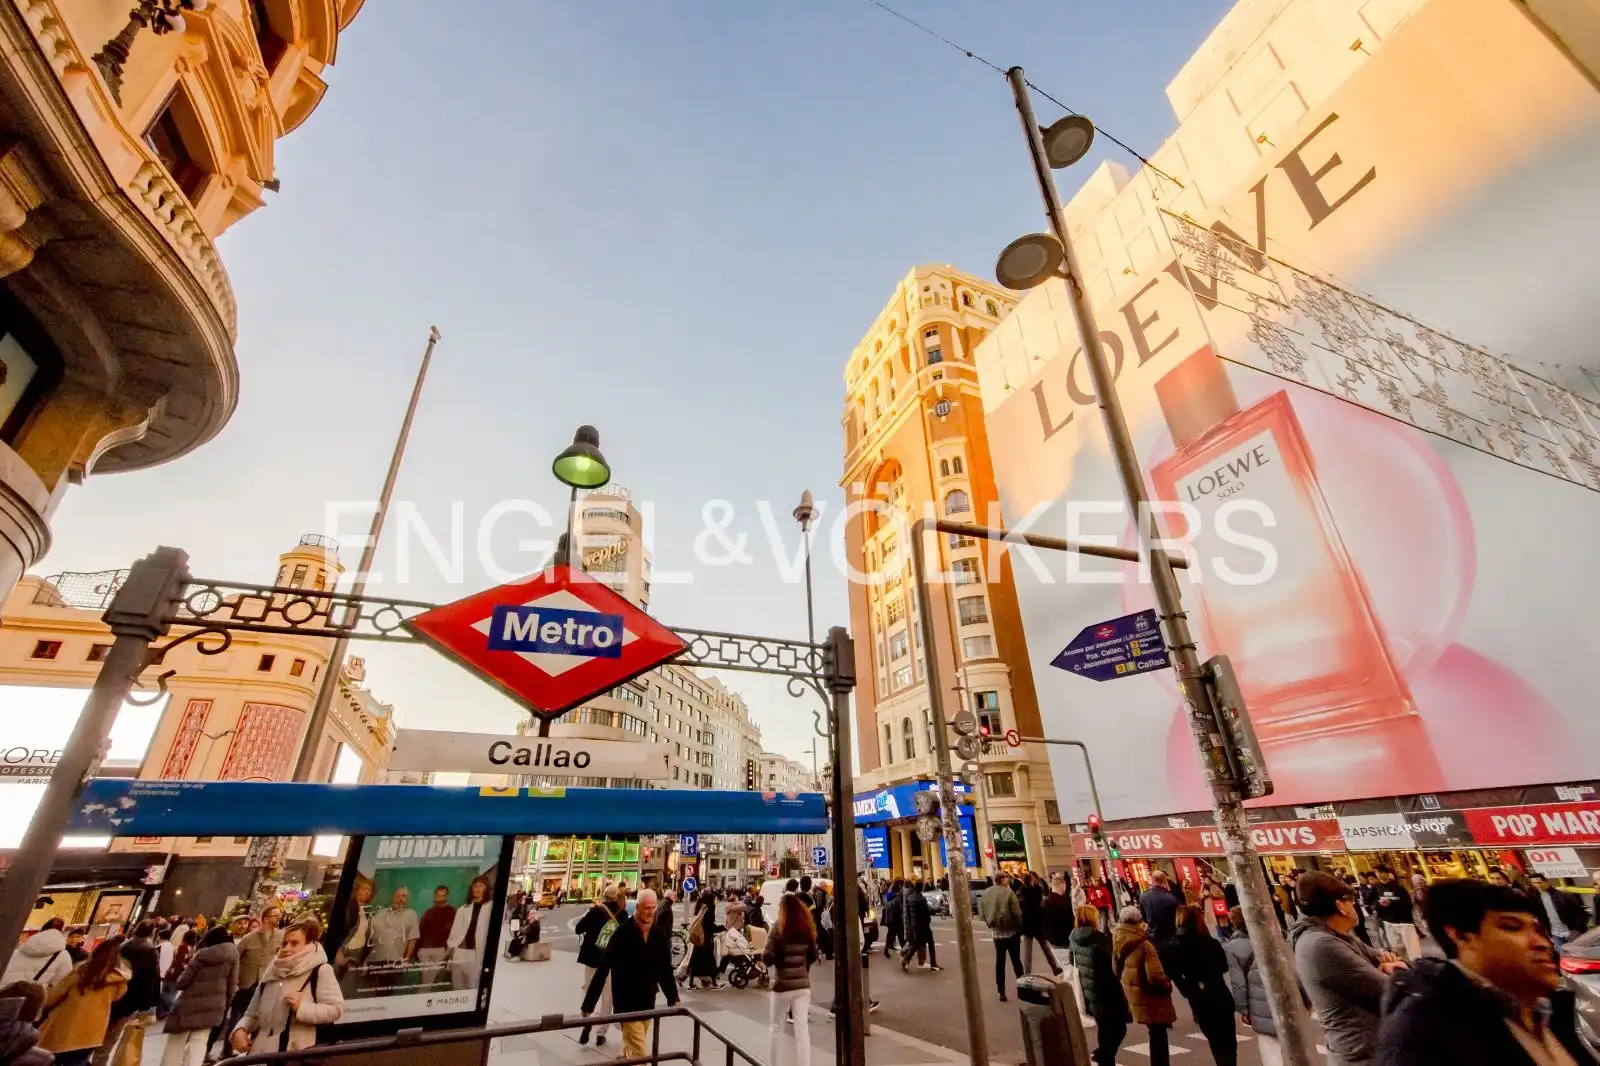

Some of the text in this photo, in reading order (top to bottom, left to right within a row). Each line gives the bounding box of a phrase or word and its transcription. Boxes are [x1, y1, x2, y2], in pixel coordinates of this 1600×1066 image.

[1030, 112, 1377, 443] LOEWE
[1187, 445, 1270, 502] LOEWE
[1217, 481, 1245, 501] SOLO
[502, 611, 614, 648] Metro
[1137, 658, 1165, 669] Callao
[488, 741, 591, 768] Callao
[853, 798, 877, 816] AMEX
[1344, 826, 1404, 838] ZAPSHO
[1491, 813, 1538, 838] POP
[376, 838, 486, 859] MUNDANA
[1120, 834, 1164, 850] GUYS
[1201, 831, 1228, 848] FI
[1252, 826, 1317, 846] GUYS
[436, 996, 469, 1005] MADRID
